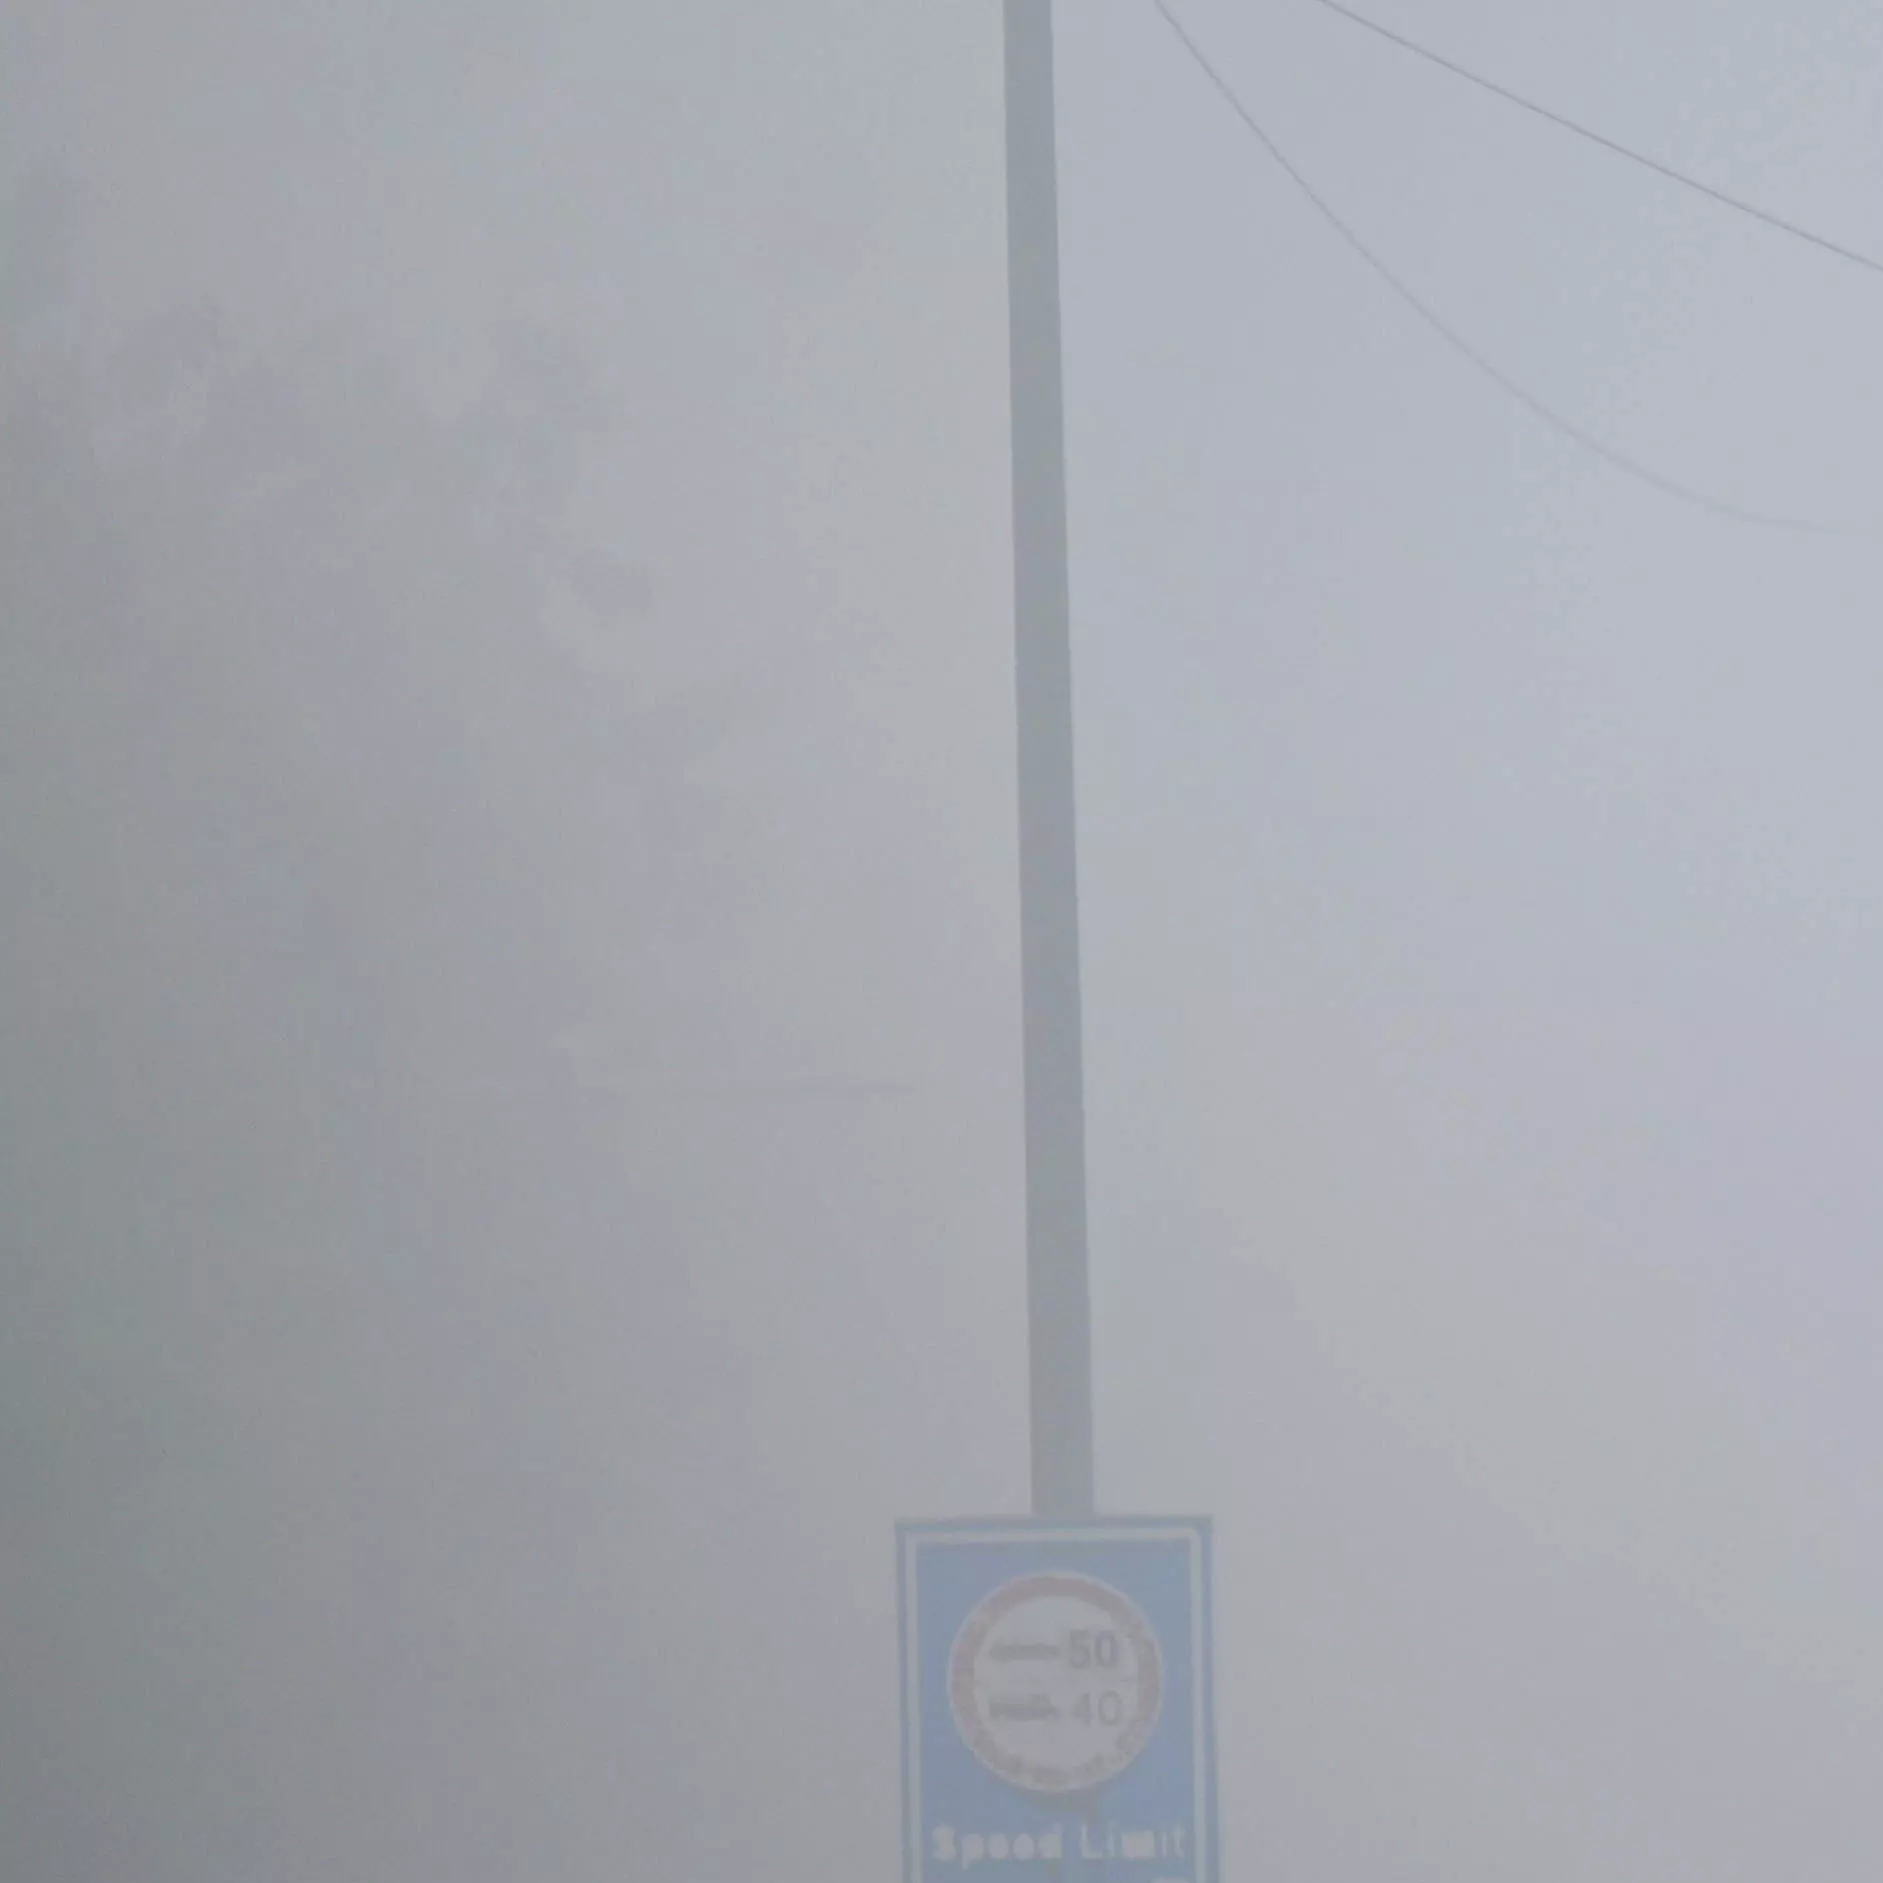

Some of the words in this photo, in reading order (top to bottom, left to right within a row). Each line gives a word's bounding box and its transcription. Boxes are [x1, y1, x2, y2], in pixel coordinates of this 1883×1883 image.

[1069, 1629, 1119, 1669] 50
[1071, 1690, 1124, 1727] 40
[933, 1821, 1063, 1870] Speed
[1080, 1820, 1186, 1861] Limit
